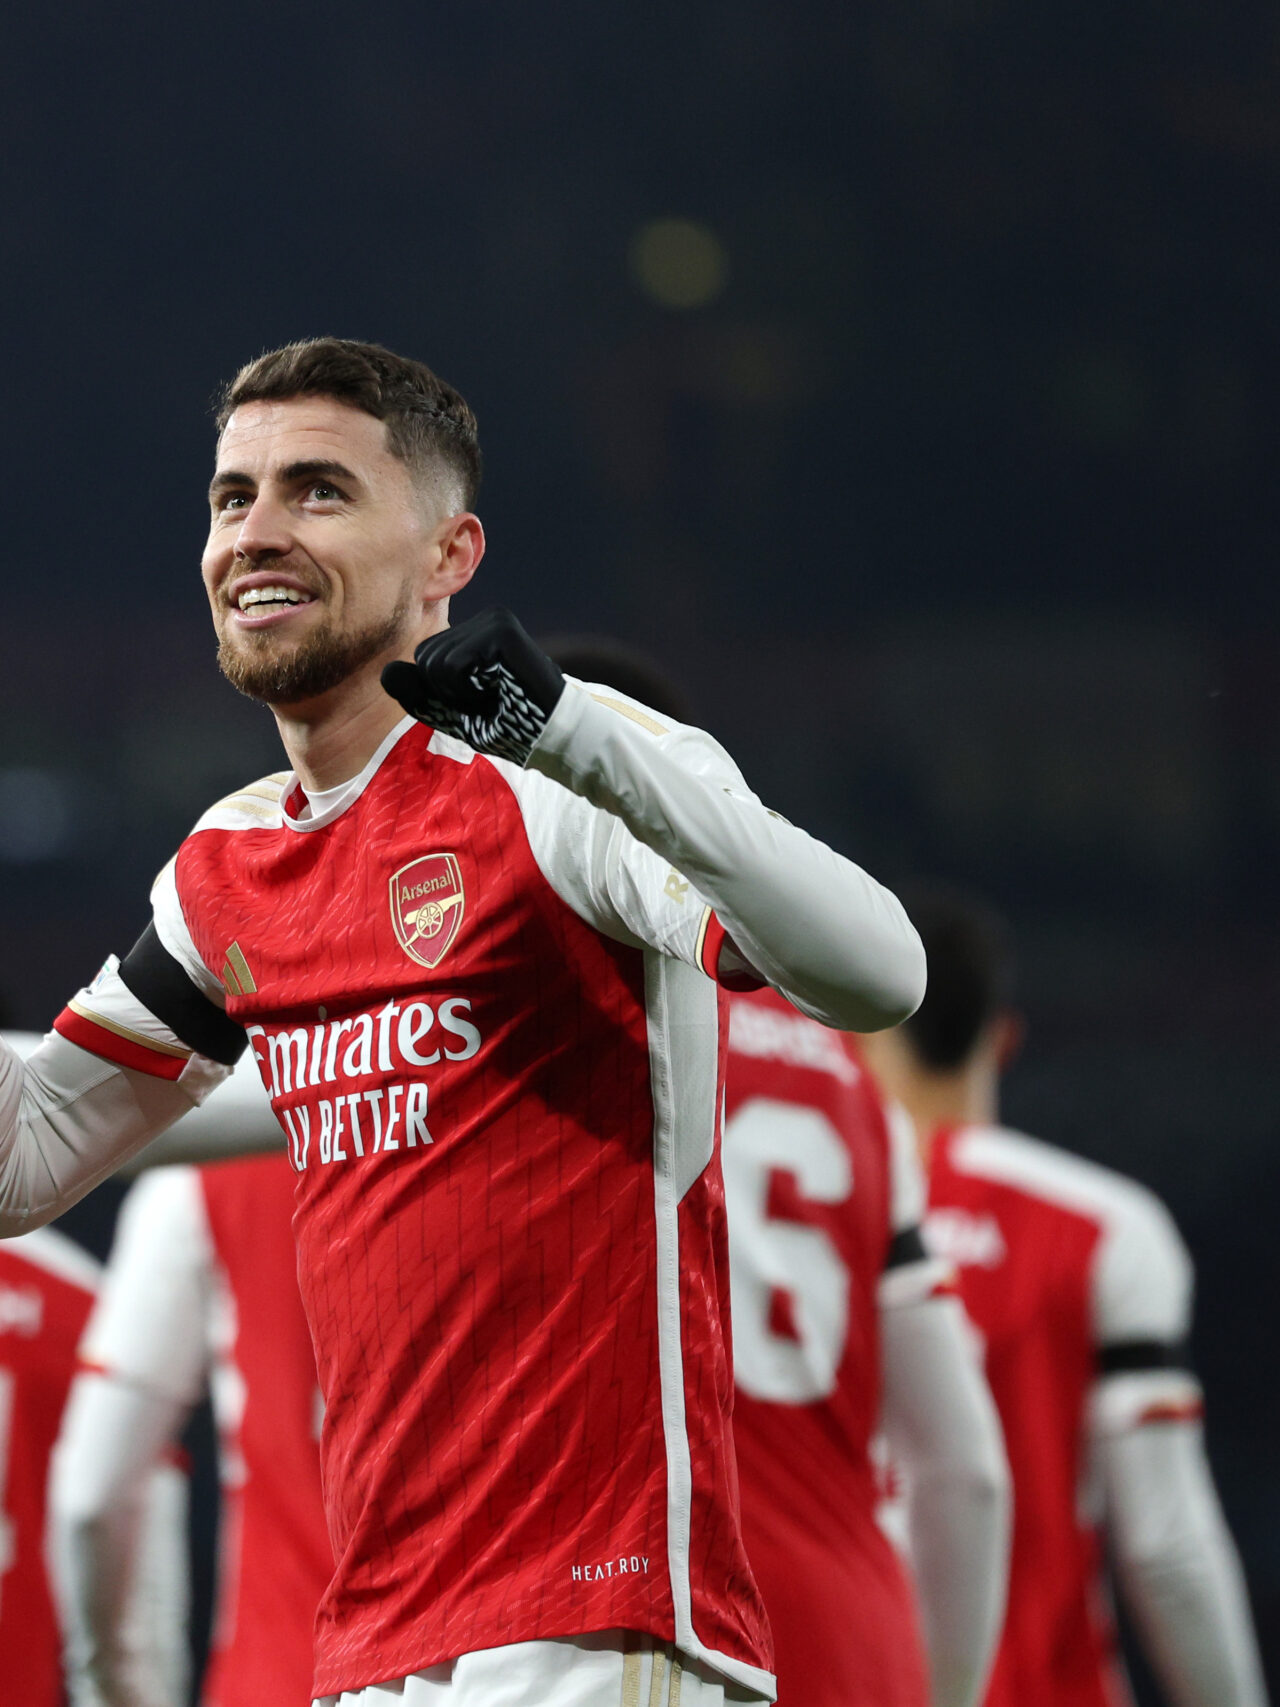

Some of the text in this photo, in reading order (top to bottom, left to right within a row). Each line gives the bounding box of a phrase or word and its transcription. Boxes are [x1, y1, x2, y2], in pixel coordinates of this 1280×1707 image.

[401, 869, 452, 904] Arsenal
[318, 1082, 434, 1165] BETTER
[721, 1095, 853, 1404] 6
[572, 1556, 649, 1581] HEAT.RDY
